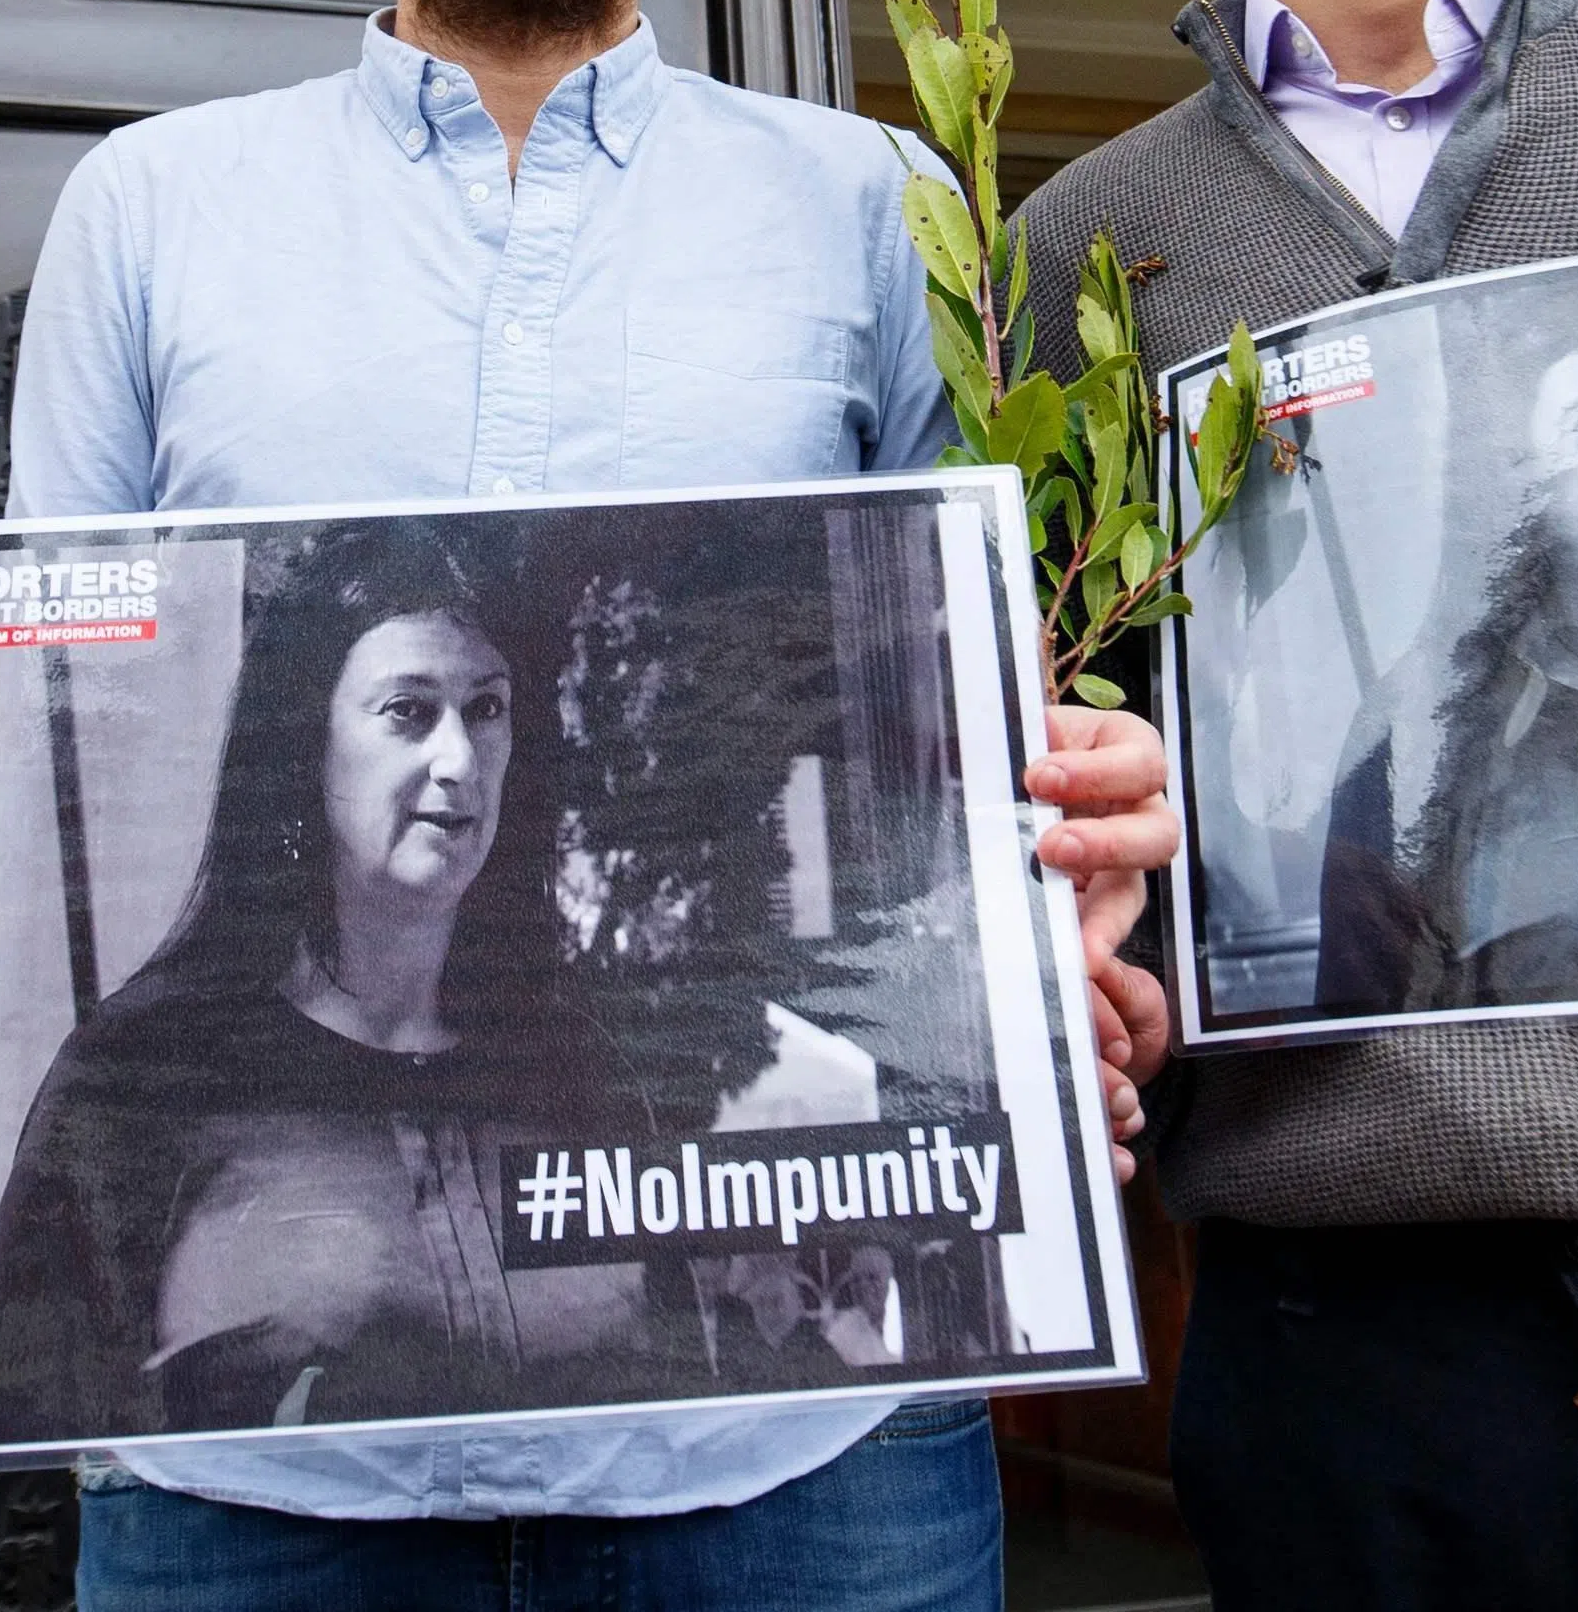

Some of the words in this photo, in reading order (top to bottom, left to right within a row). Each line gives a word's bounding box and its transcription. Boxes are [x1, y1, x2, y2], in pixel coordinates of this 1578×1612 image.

[1186, 334, 1371, 413] RRTERS
[1278, 362, 1374, 403] BORDERS
[1285, 386, 1366, 414] INFORMATION
[23, 596, 158, 623] BORDERS
[11, 628, 33, 643] OF
[35, 624, 142, 642] INFORMATION
[516, 1125, 1000, 1246] #NoImpunity
